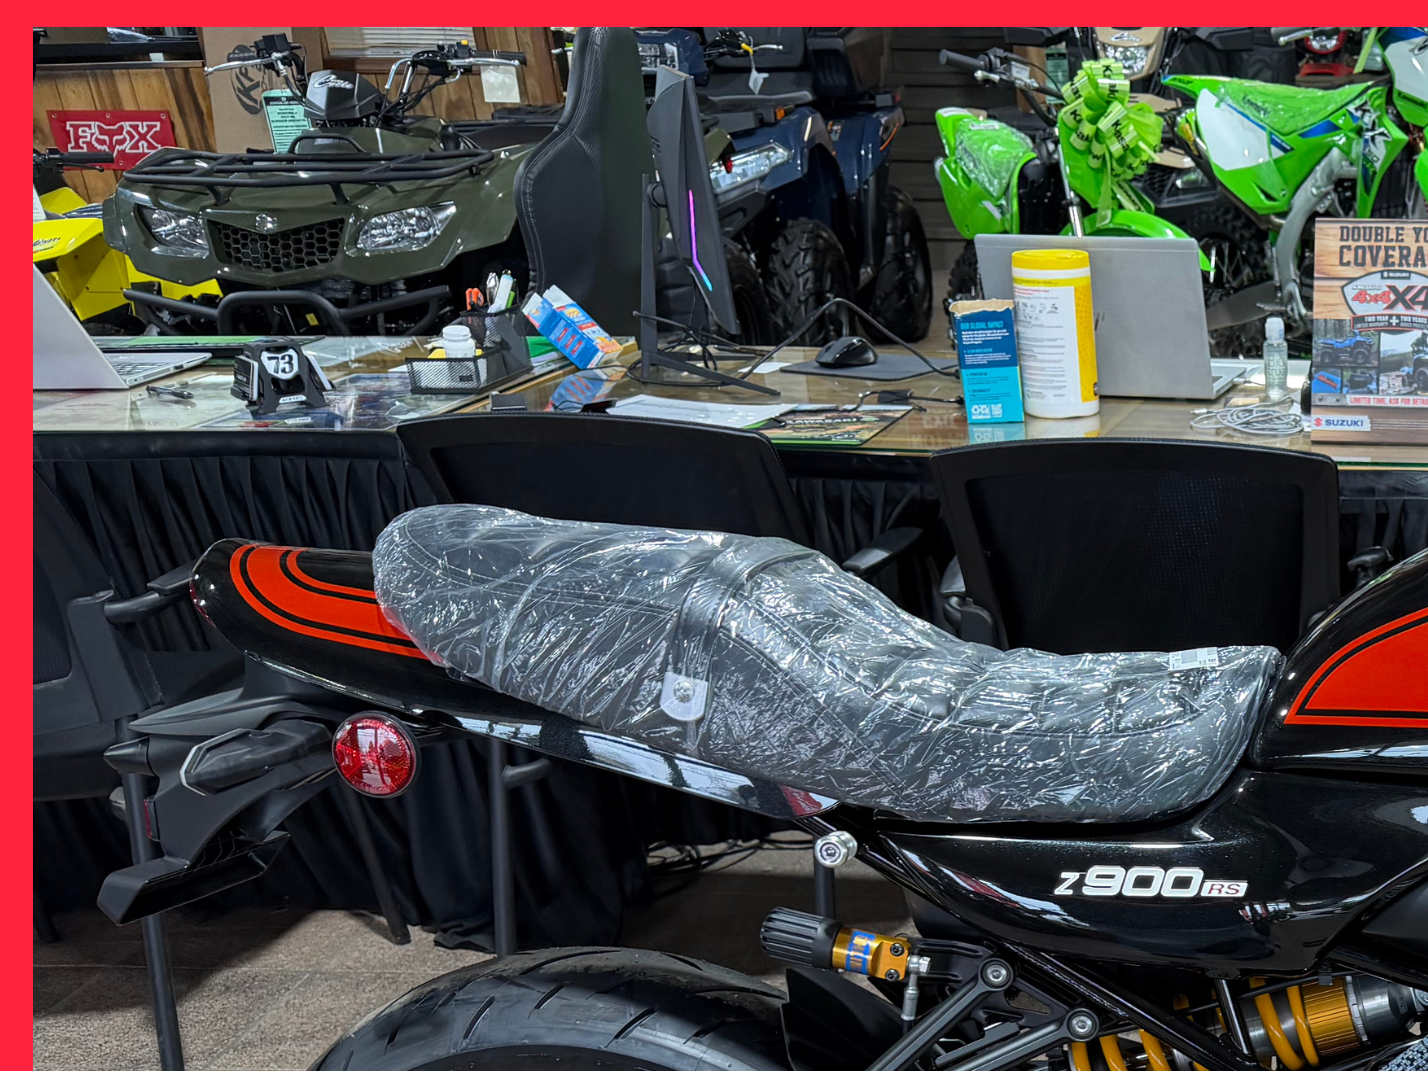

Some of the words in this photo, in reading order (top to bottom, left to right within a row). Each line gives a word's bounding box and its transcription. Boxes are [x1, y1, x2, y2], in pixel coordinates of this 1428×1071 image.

[1339, 225, 1405, 243] DOUBLE
[266, 353, 295, 375] 73
[1349, 396, 1371, 405] LIMITED
[1388, 396, 1399, 405] ASK
[1400, 397, 1411, 405] FOR
[1324, 418, 1364, 428] SUZUKI
